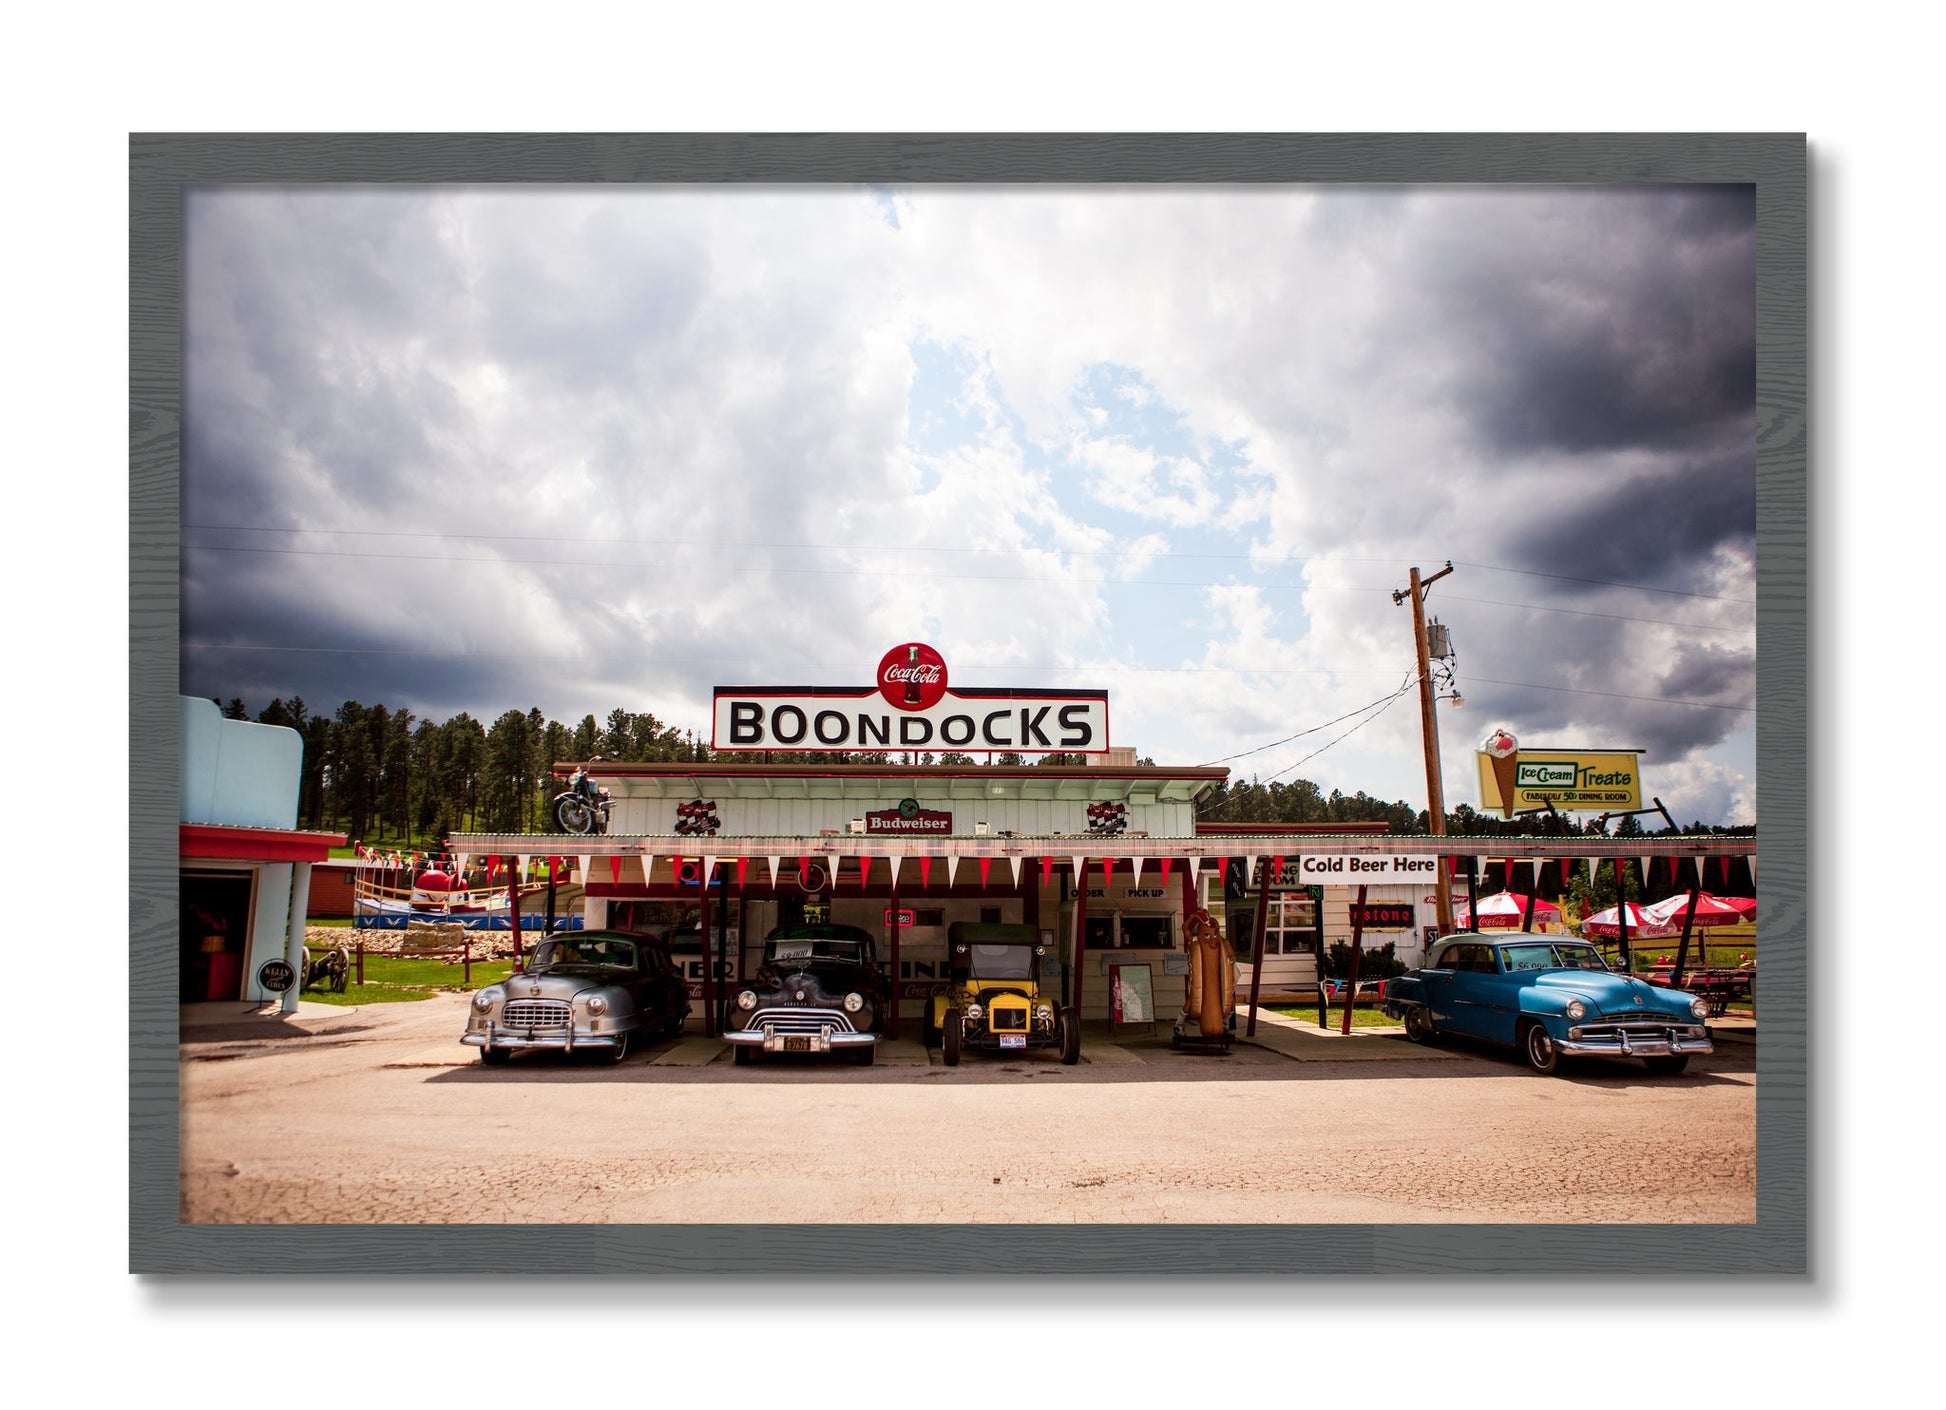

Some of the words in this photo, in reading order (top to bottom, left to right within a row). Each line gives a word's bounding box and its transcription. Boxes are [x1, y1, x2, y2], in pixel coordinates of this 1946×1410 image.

[884, 663, 942, 684] Coca-Cola
[730, 701, 1092, 746] BOONDOCKS
[1578, 766, 1631, 788] Treats
[1526, 792, 1562, 800] FABULOUS
[1579, 792, 1602, 800] DINING
[1605, 792, 1627, 800] ROOM
[870, 817, 948, 829] Budweiser
[1303, 857, 1343, 872] Cold
[1349, 857, 1388, 872] Beer
[1393, 857, 1435, 872] Here
[1071, 889, 1105, 898] ODER
[1128, 889, 1149, 898] PICK
[1151, 889, 1164, 898] UP
[1479, 916, 1506, 926] Coca-Cola
